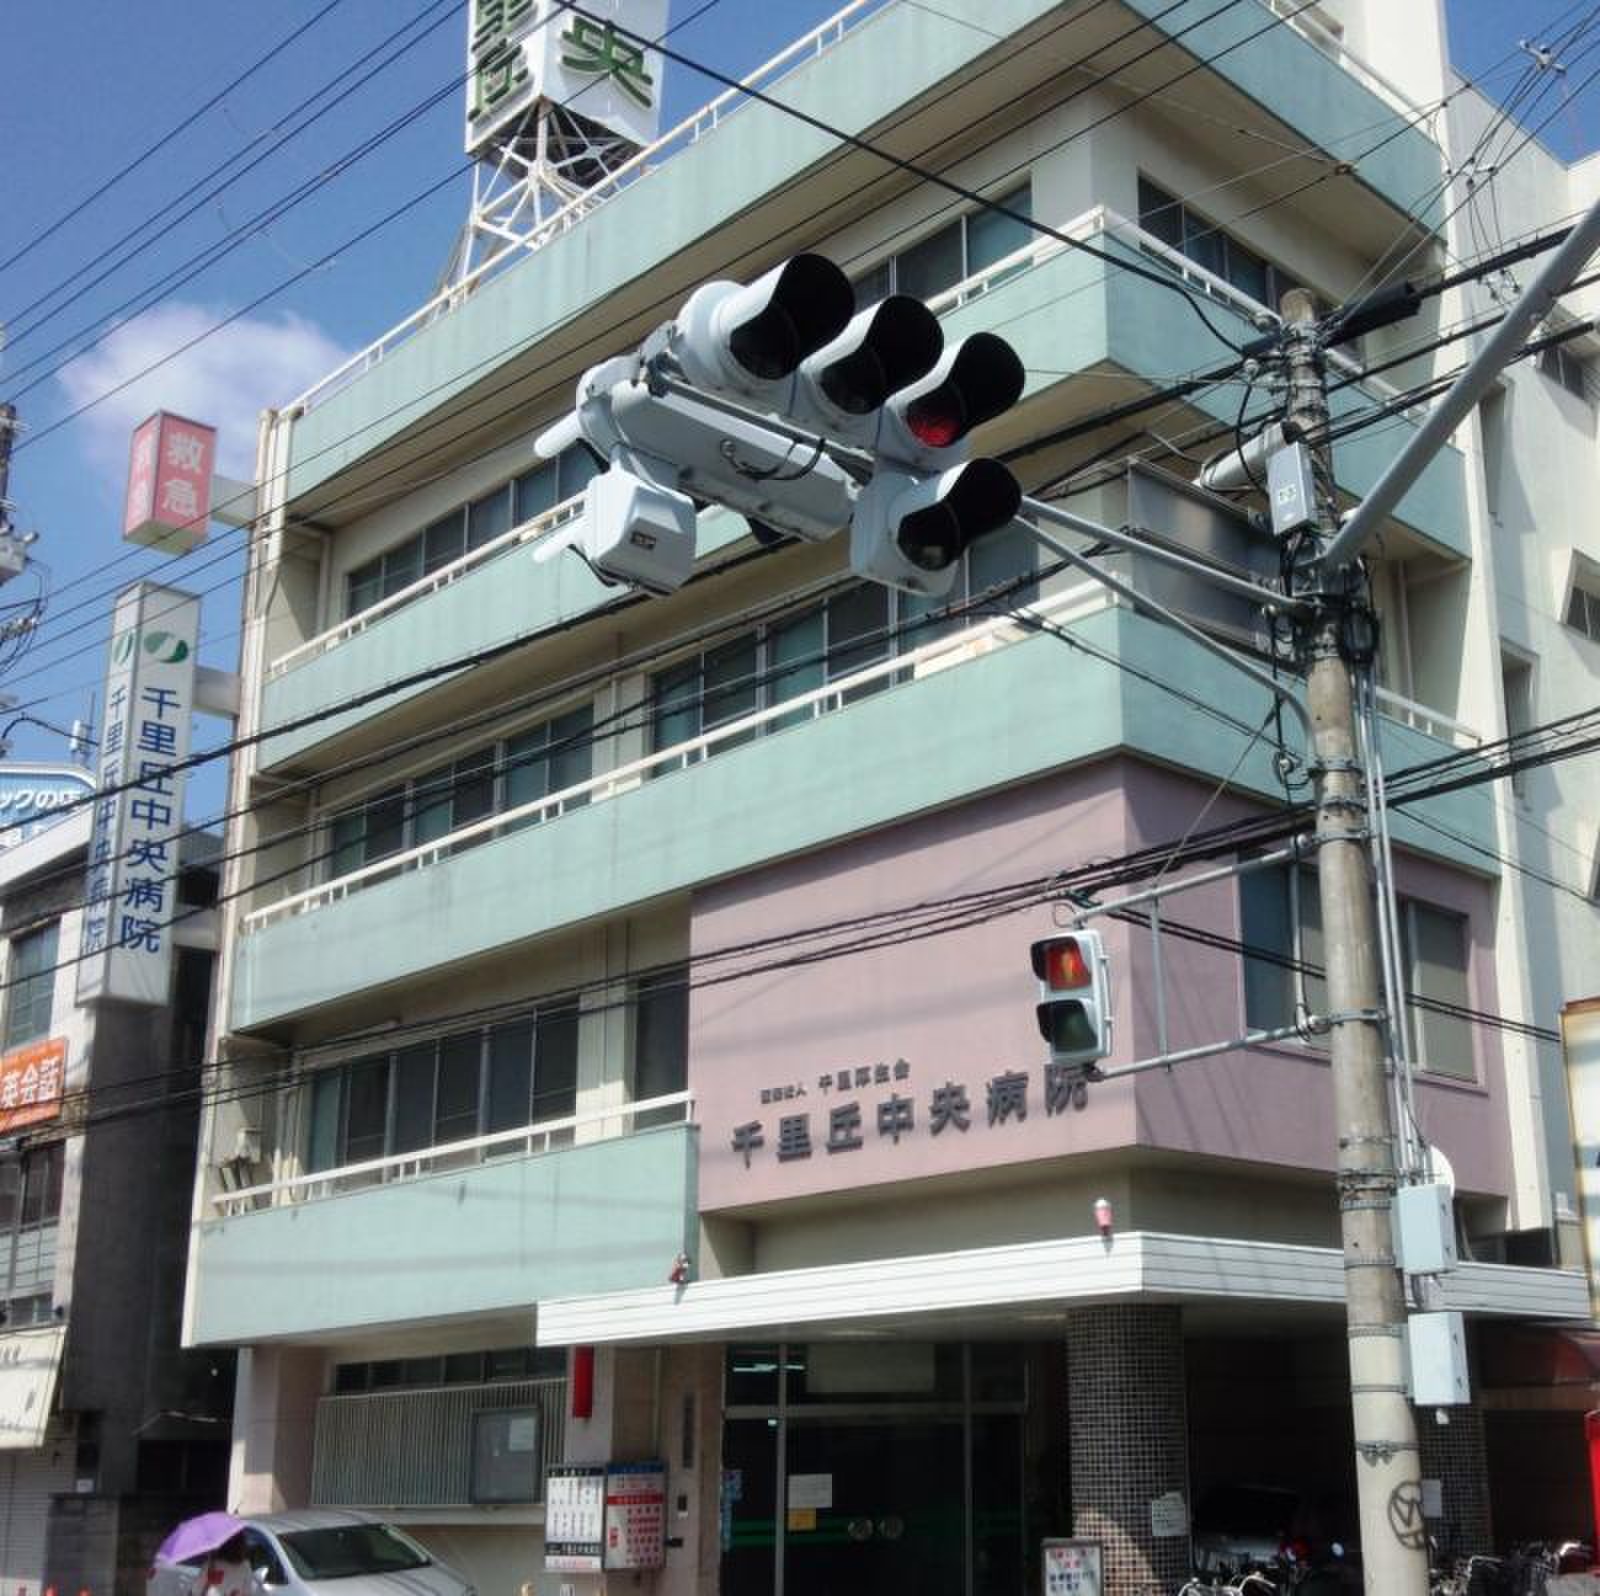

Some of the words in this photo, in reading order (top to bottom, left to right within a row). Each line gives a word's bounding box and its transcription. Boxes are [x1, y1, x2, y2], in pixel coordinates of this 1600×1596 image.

[561, 14, 654, 108] 央
[163, 432, 205, 518] 救急
[119, 686, 182, 954] 千里丘中央病院
[731, 1062, 1089, 1169] 千里丘中央病院
